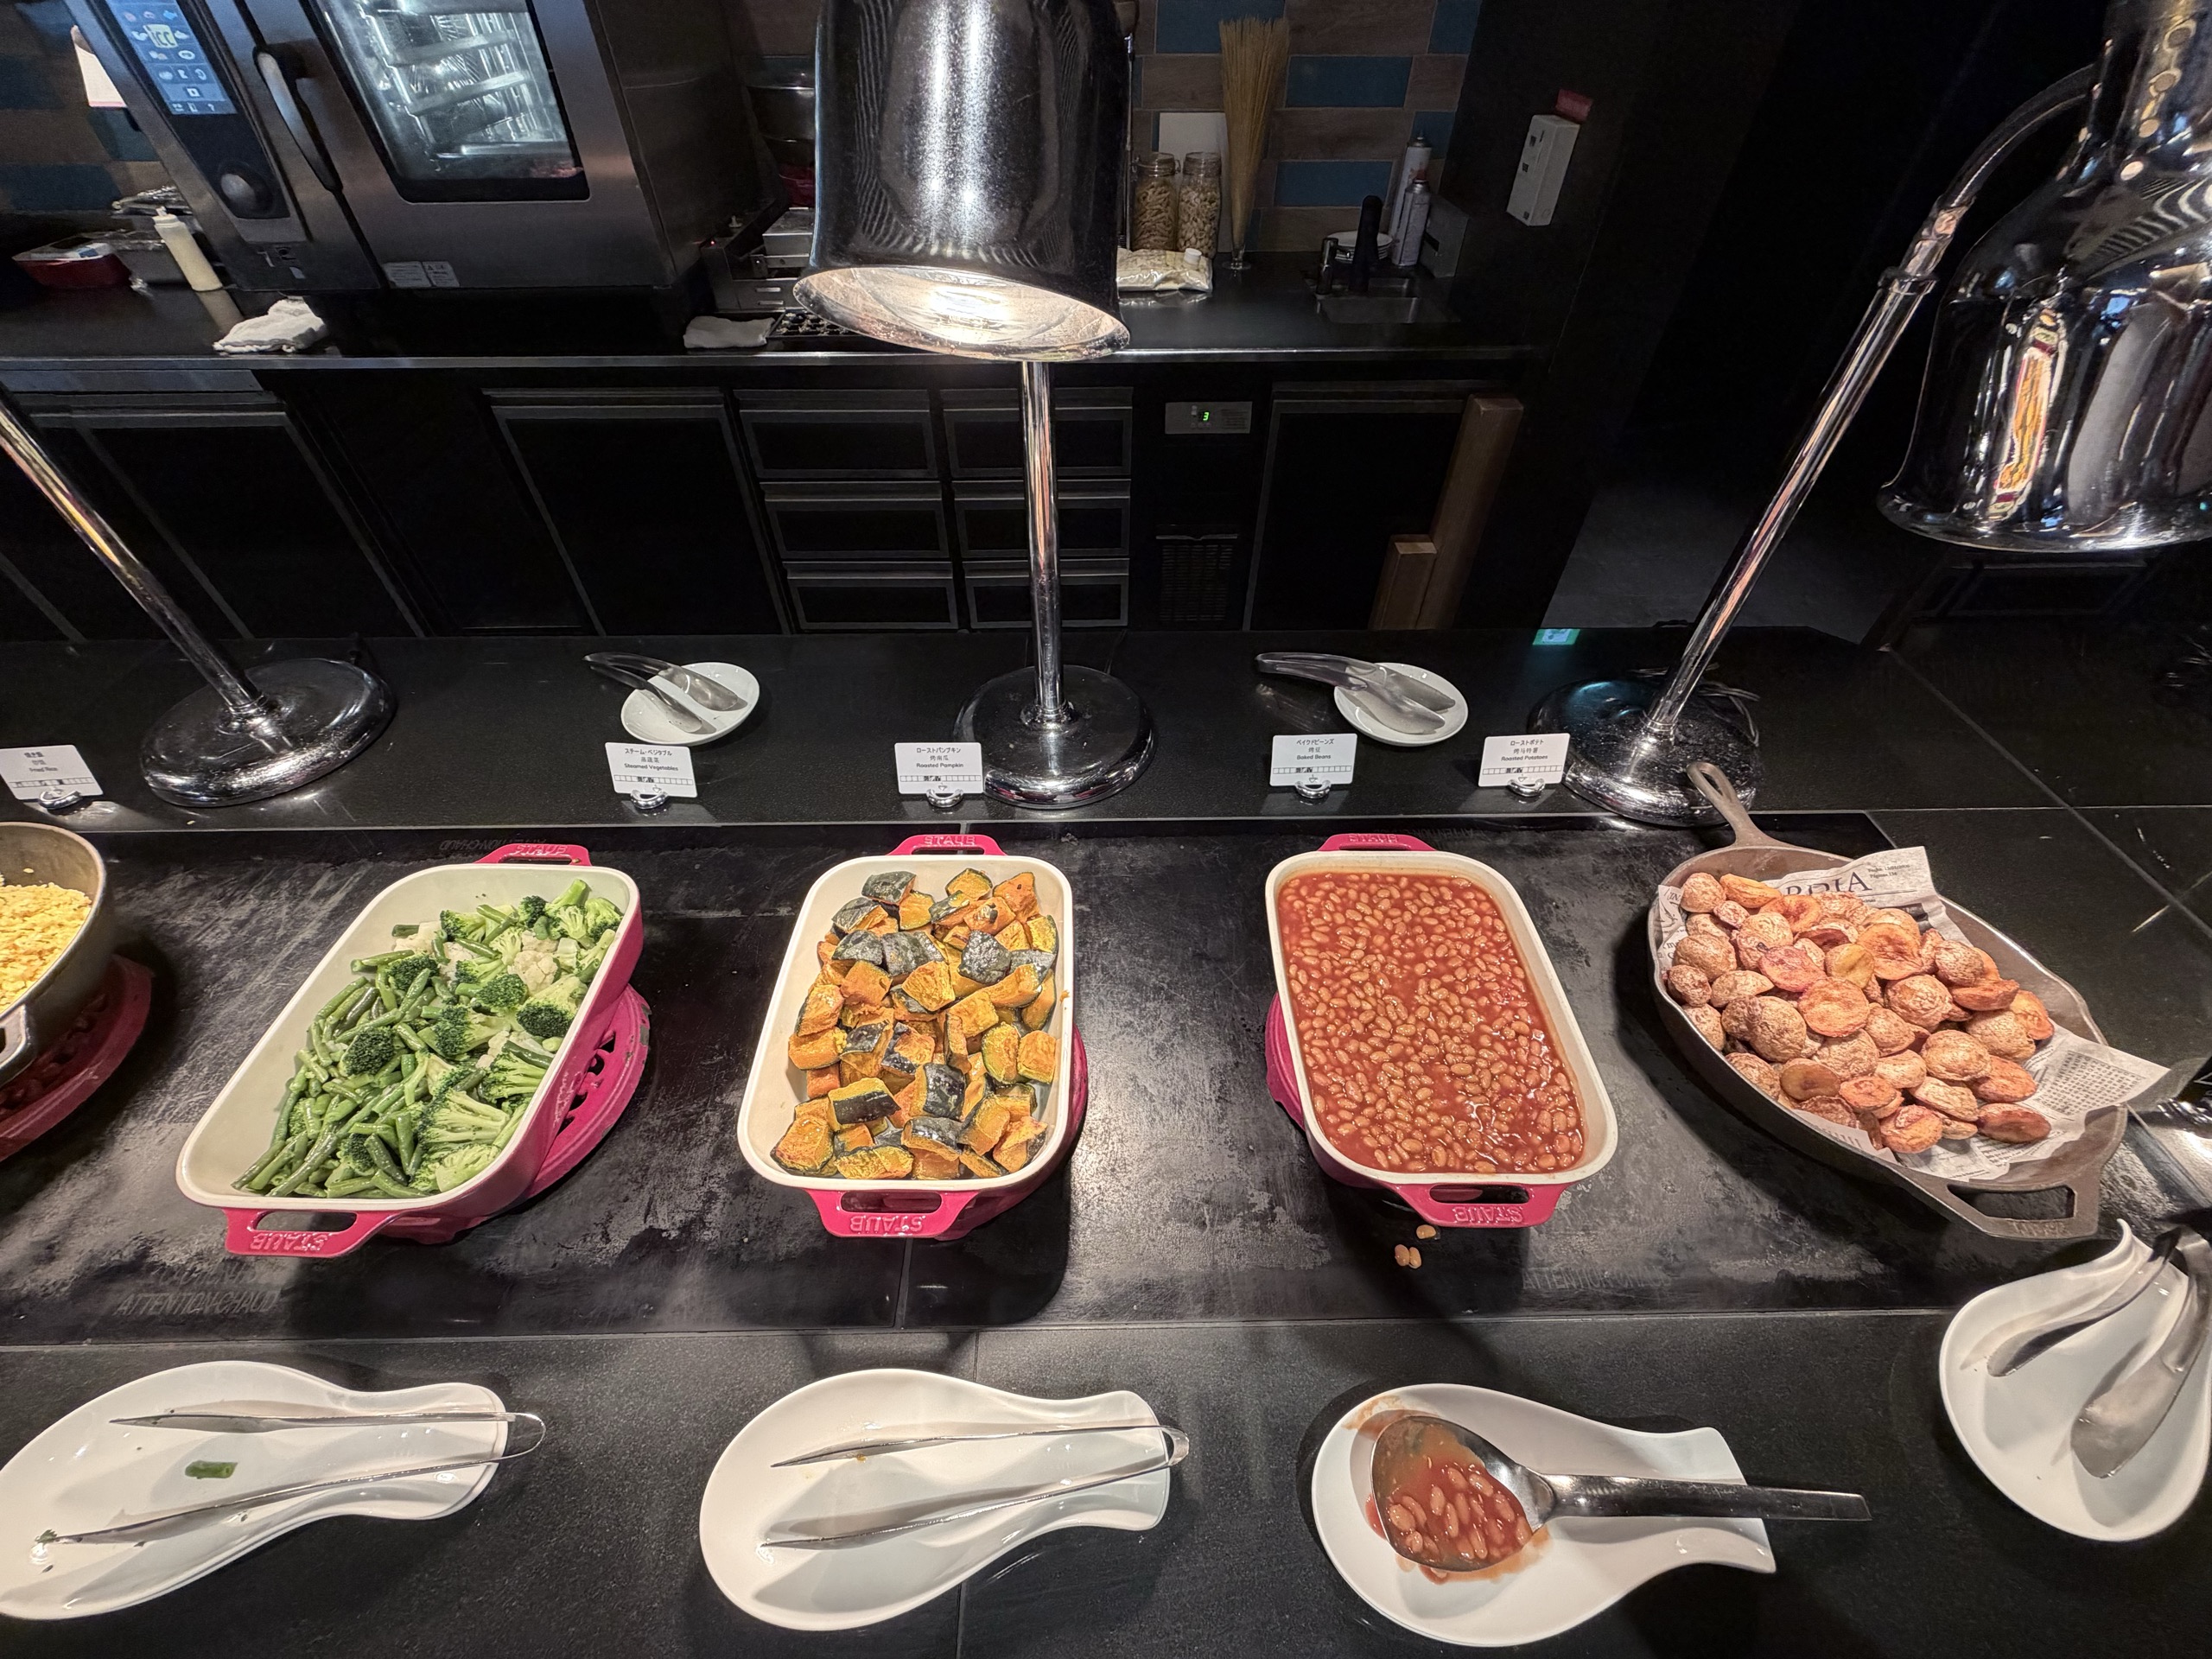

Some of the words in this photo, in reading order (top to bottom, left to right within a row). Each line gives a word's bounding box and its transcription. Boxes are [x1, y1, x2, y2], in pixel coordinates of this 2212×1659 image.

[925, 836, 976, 846] STAUB
[1452, 1205, 1523, 1223] STAUB
[850, 1215, 926, 1233] STAUB
[250, 1232, 328, 1251] STAUB
